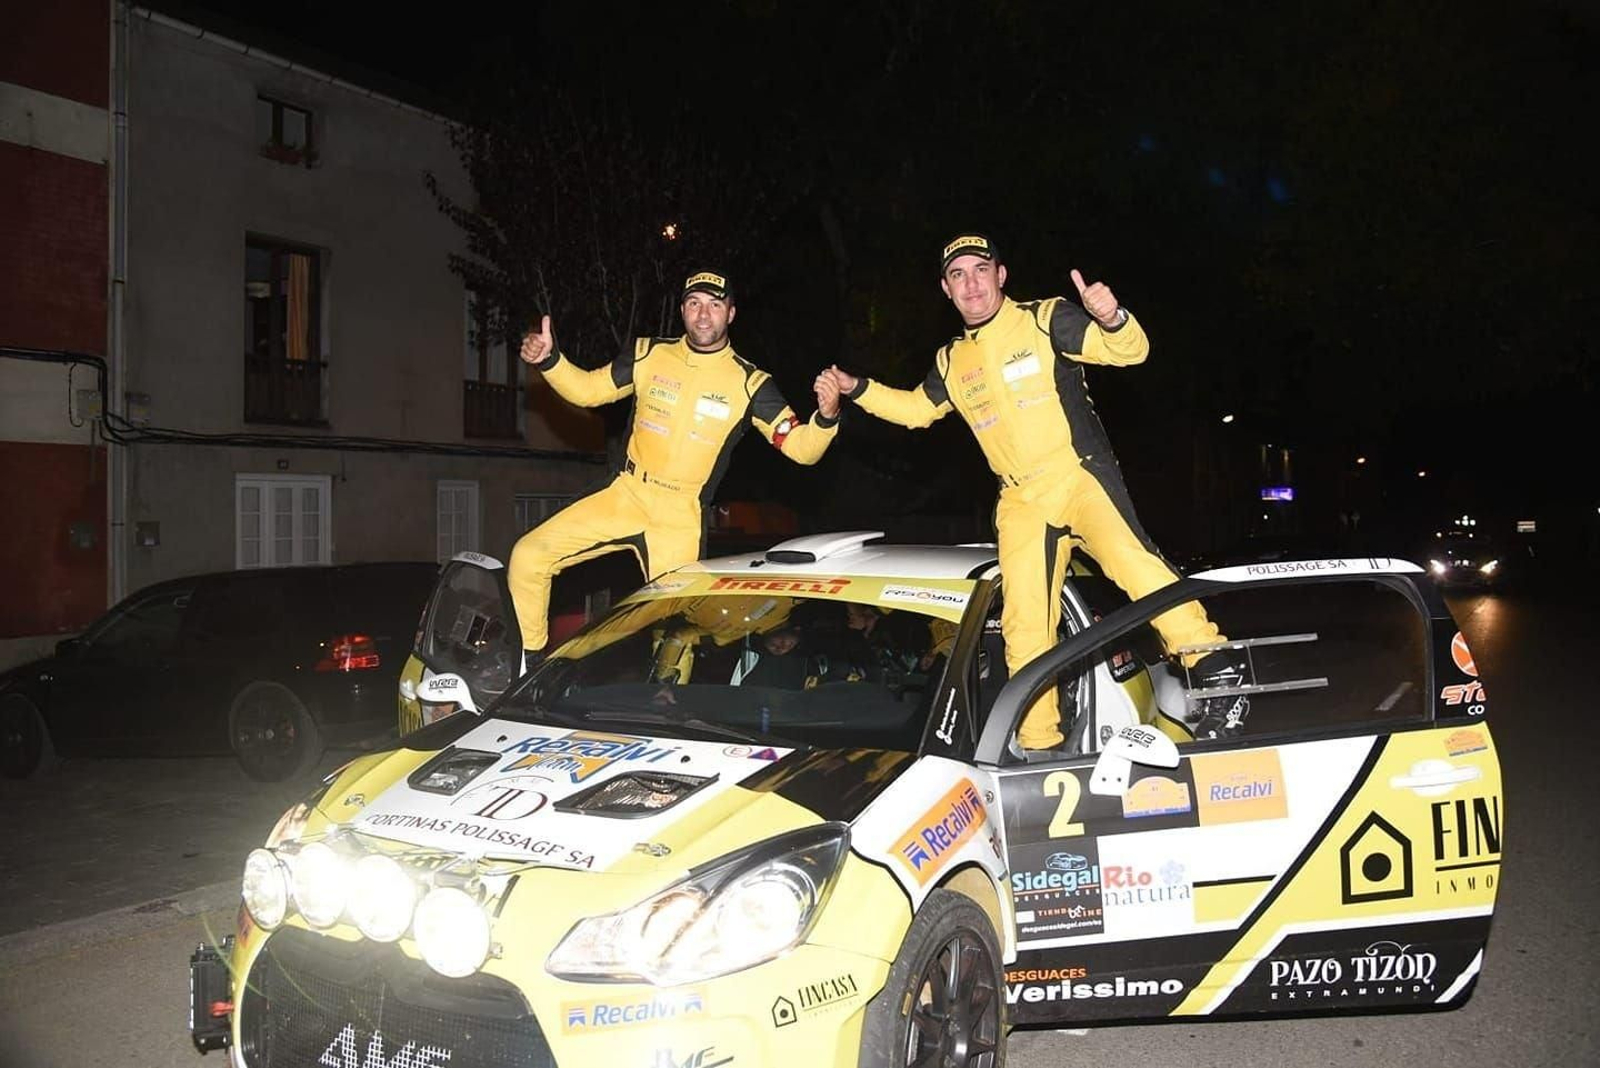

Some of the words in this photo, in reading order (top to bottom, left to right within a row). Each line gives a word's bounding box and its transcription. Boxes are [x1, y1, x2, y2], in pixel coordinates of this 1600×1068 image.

[1247, 560, 1325, 575] POLISSAGE
[1328, 559, 1347, 569] SA
[709, 577, 852, 595] PIRELLI
[505, 737, 682, 764] Recalvi
[1209, 780, 1273, 801] Recalvi
[1043, 771, 1085, 839] 2
[921, 795, 974, 858] Recalvi
[1431, 796, 1501, 861] FIN
[365, 813, 454, 832] CORTINAS
[565, 852, 596, 869] SA
[1012, 865, 1099, 892] Sidegal
[1103, 866, 1152, 889] Rio
[1436, 873, 1494, 896] INMO
[1104, 884, 1191, 907] natura
[1270, 957, 1343, 987] PAZO
[1005, 977, 1184, 1005] Verissimo
[1271, 985, 1436, 1001] EXTRAMUNDI
